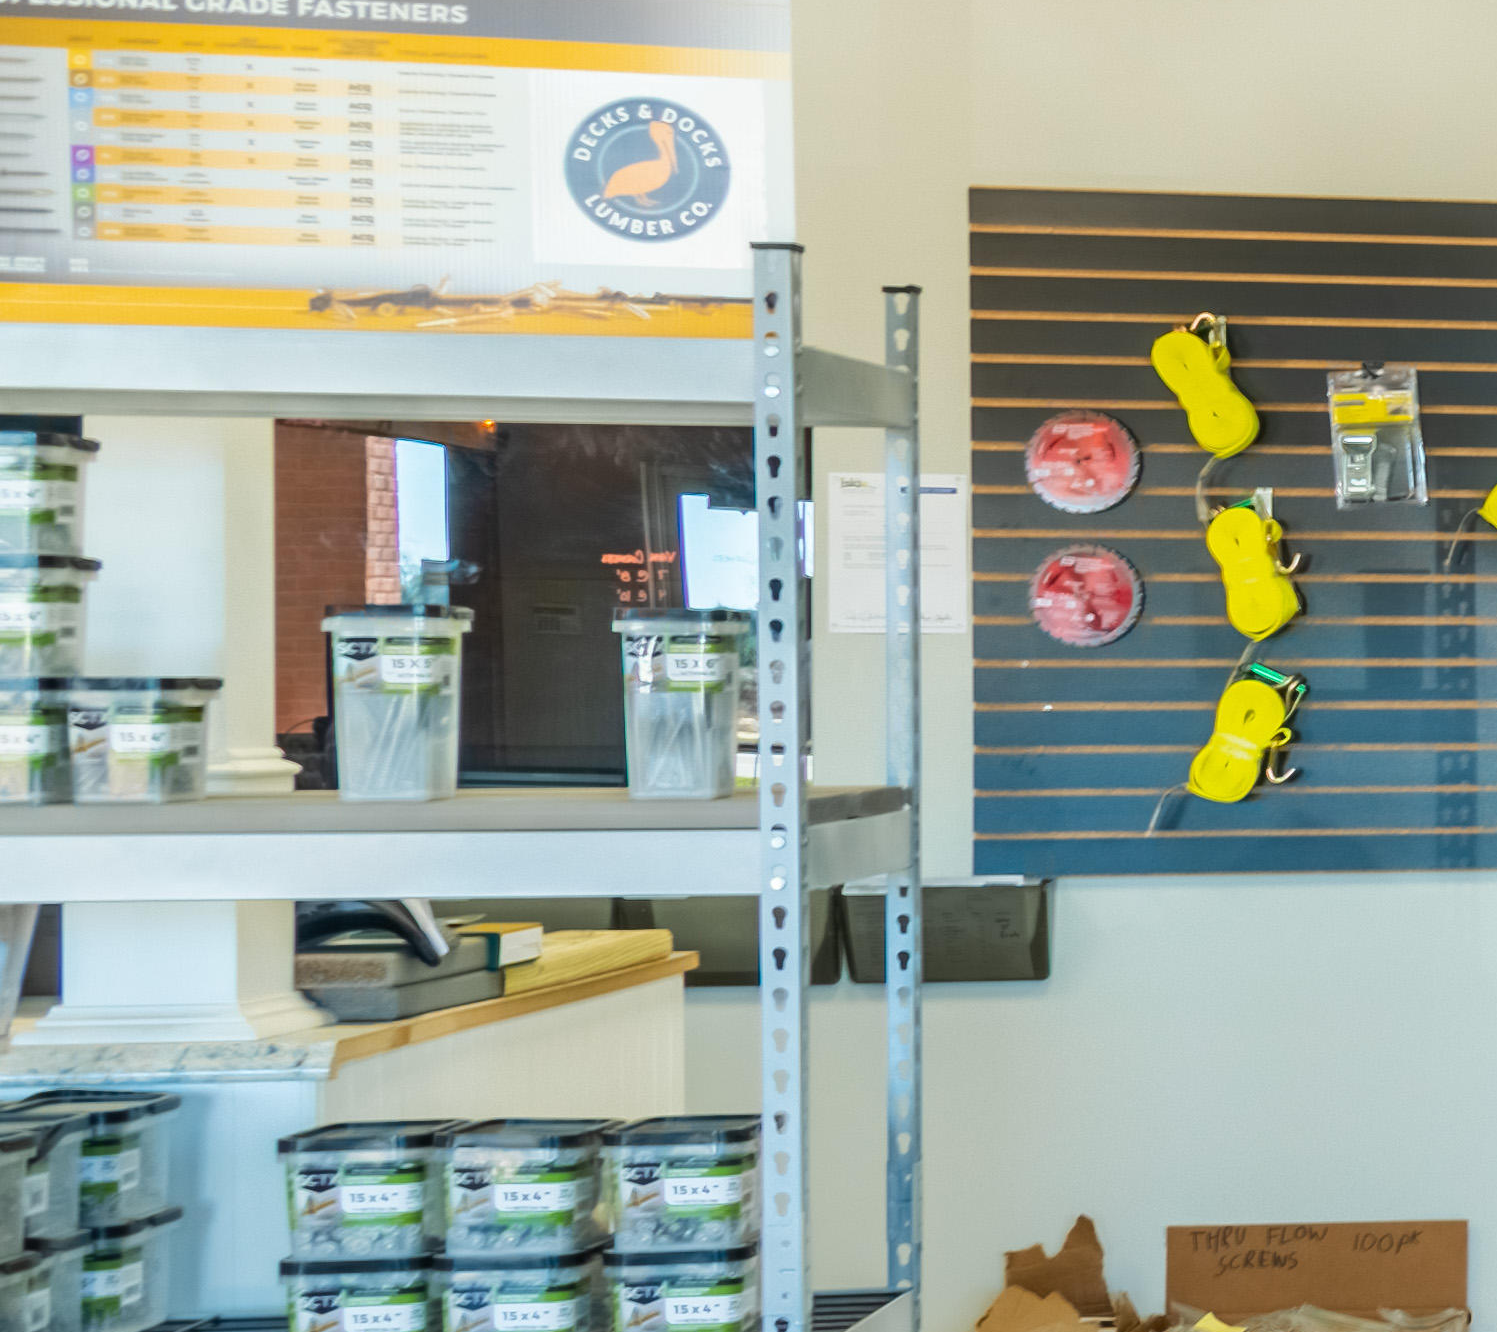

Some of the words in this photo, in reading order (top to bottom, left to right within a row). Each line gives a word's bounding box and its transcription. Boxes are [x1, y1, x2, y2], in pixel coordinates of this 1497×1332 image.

[573, 106, 630, 162] DECKS
[638, 103, 653, 119] &
[660, 107, 722, 168] DOCKS
[584, 194, 675, 236] LUMBER
[679, 201, 713, 226] CO.
[1189, 1225, 1247, 1253] THRU
[1266, 1225, 1329, 1246] FLOW
[1213, 1249, 1299, 1277] SCREWS
